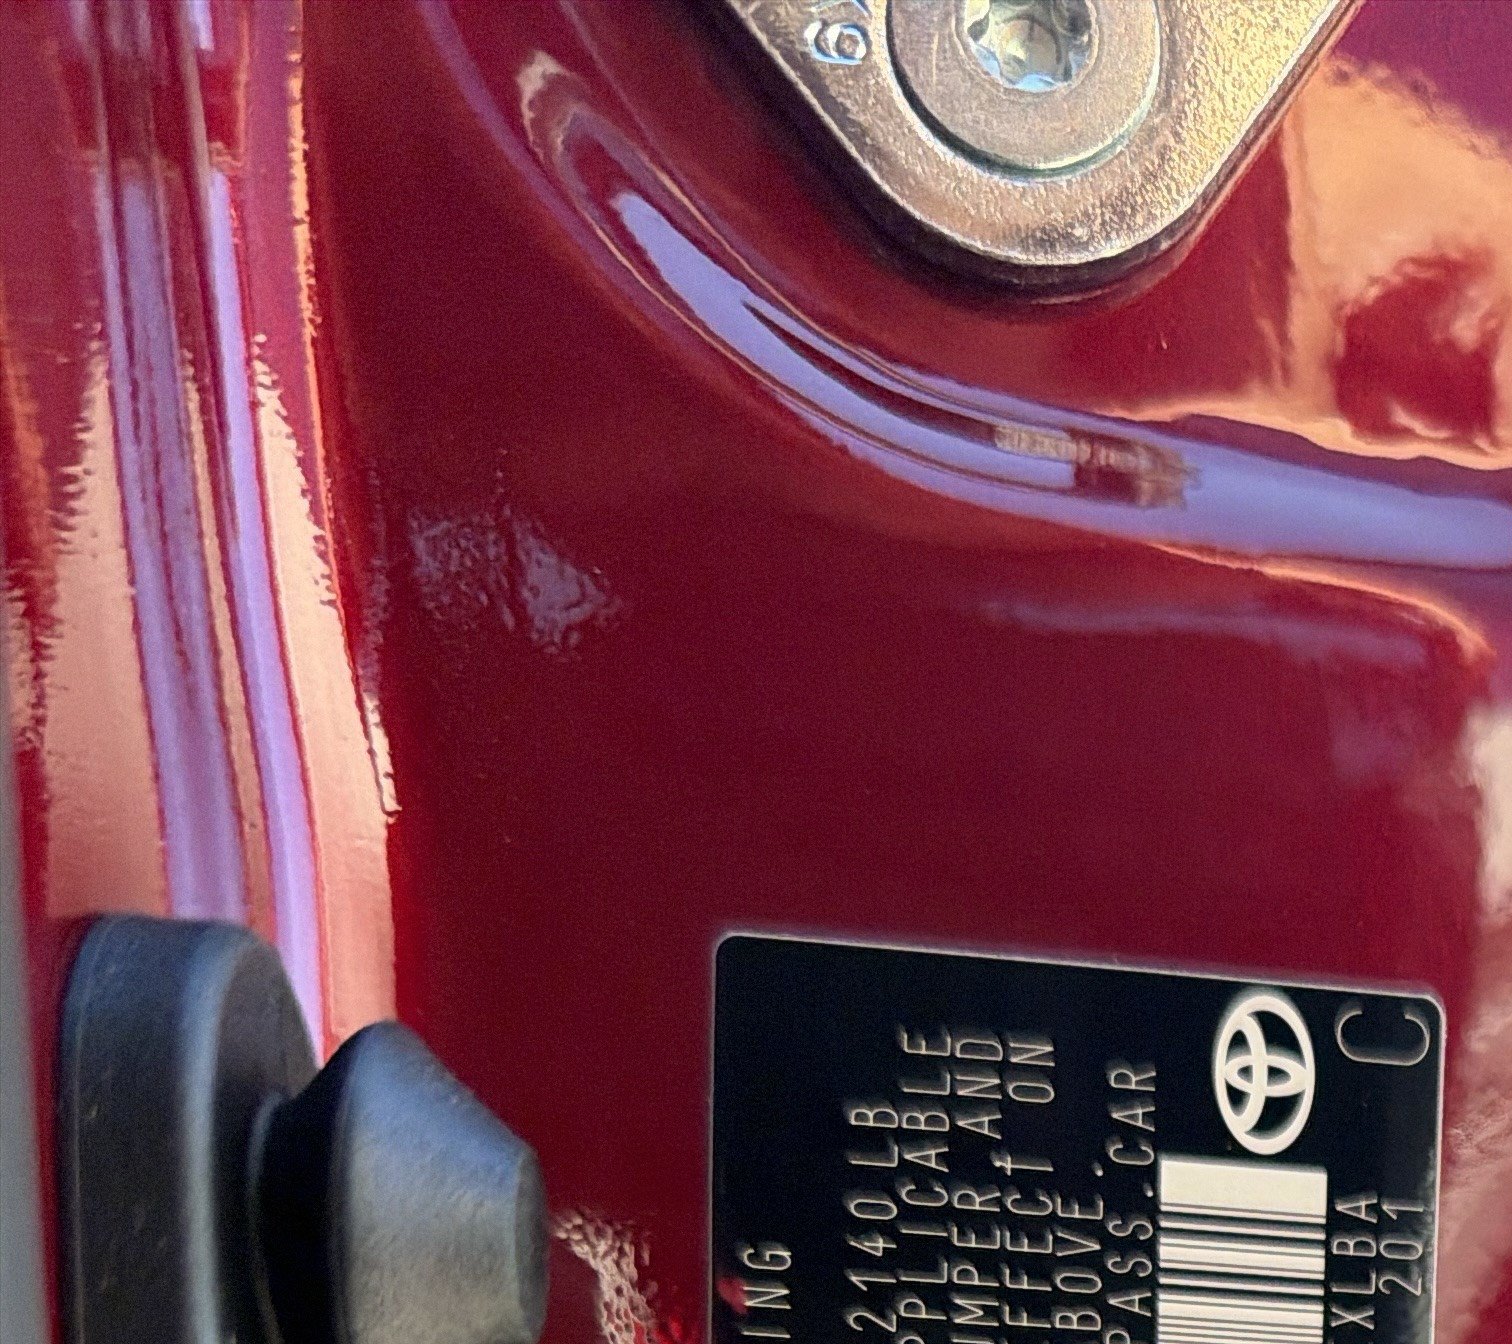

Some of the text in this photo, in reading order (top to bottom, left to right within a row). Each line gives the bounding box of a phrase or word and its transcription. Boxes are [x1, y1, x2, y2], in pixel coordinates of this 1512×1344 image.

[1335, 1009, 1430, 1066] C
[1008, 1042, 1056, 1103] ON
[850, 1107, 898, 1166] LB
[847, 1197, 897, 1332] 2140
[1377, 1203, 1424, 1295] 201
